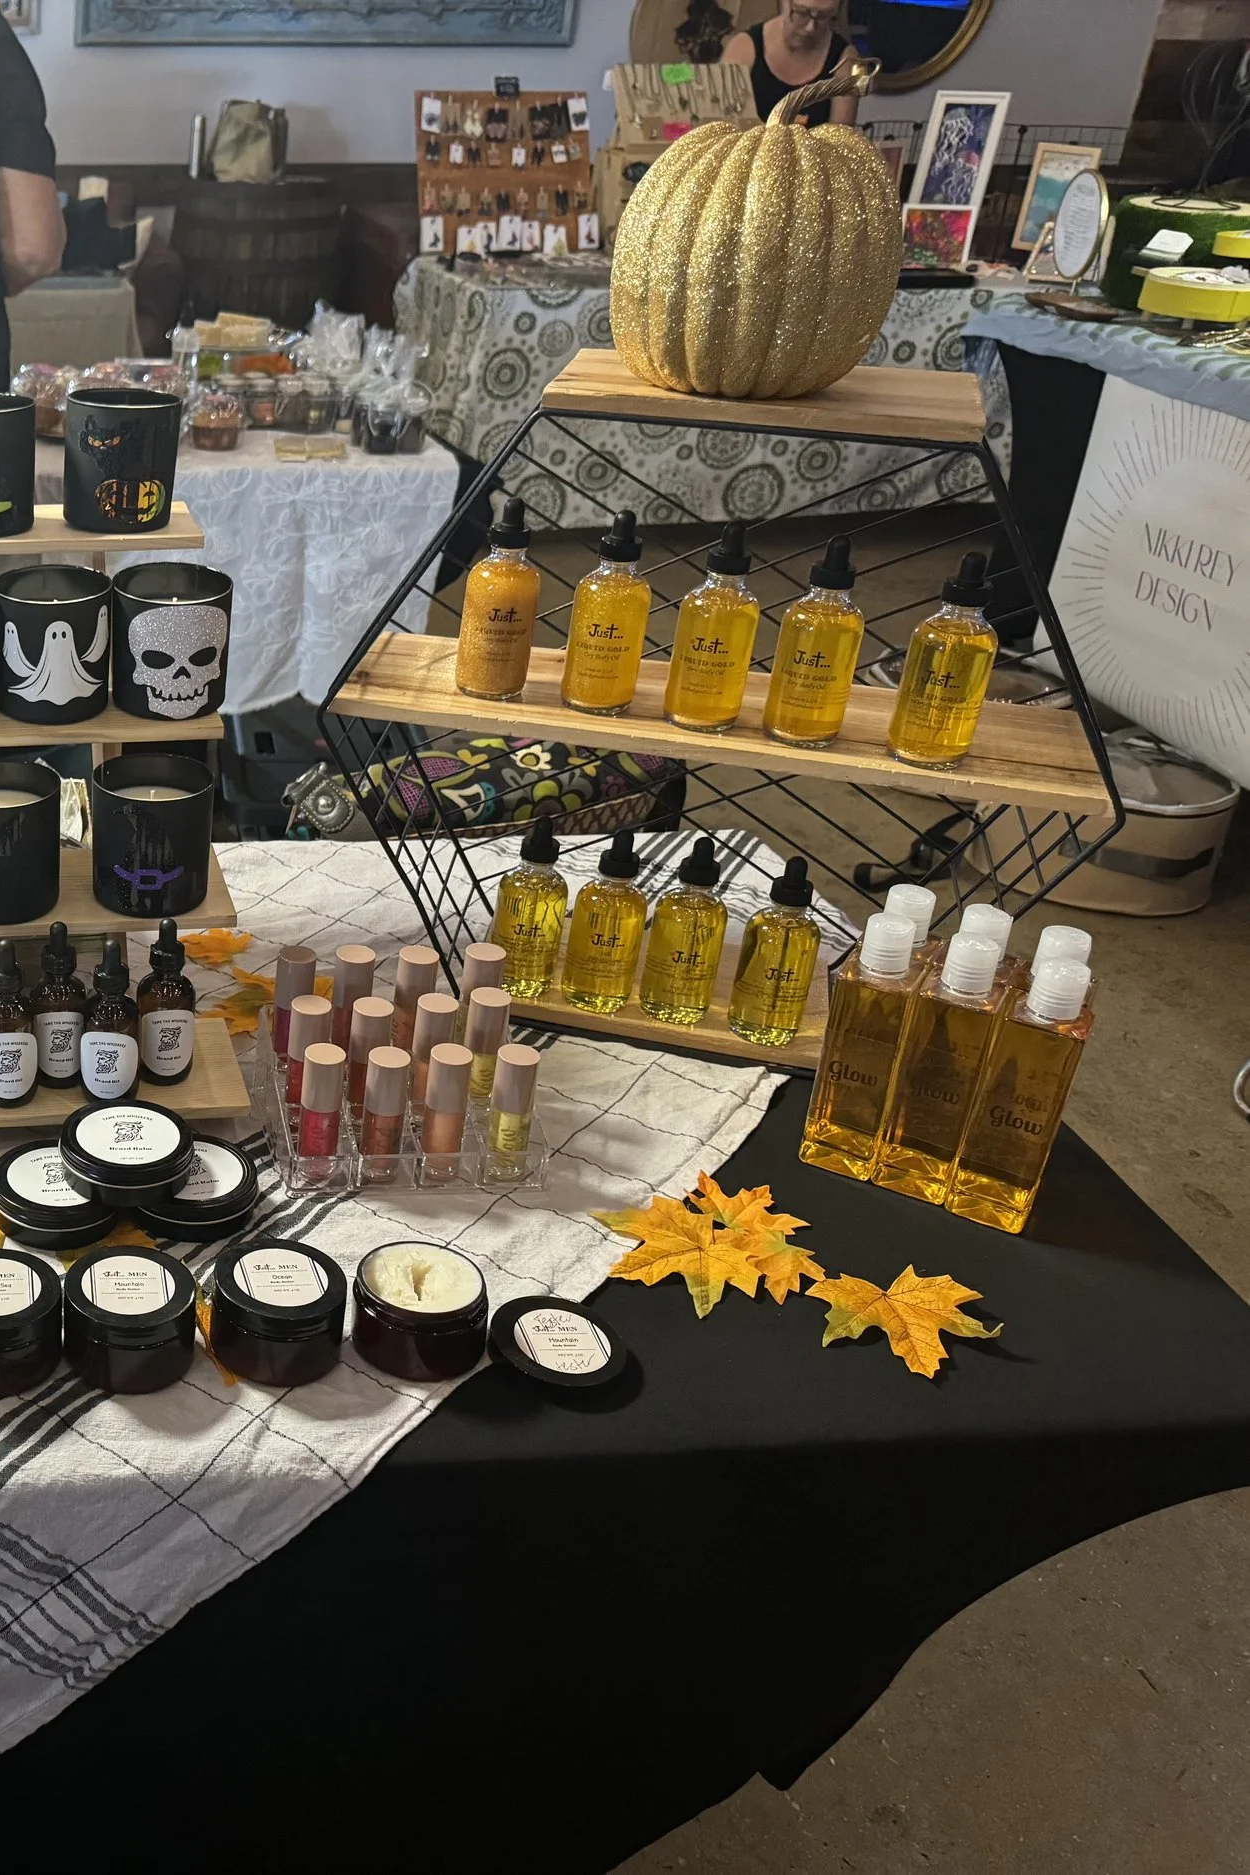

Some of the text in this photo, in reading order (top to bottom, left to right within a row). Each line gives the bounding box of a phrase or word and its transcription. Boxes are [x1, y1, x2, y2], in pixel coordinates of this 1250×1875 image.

[1140, 522, 1243, 587] NIKKI REY
[1135, 571, 1218, 632] DESIGN
[488, 607, 522, 623] Just...
[588, 623, 624, 640] Just...
[576, 641, 630, 653] LIQUID GOLD
[692, 637, 728, 655] Just...
[793, 650, 831, 668] Just...
[812, 674, 838, 682] GOLD
[923, 669, 961, 688] Just...
[514, 923, 546, 938] Just...
[592, 932, 625, 948] Just...
[672, 950, 706, 966] Just...
[765, 968, 800, 982] Just...
